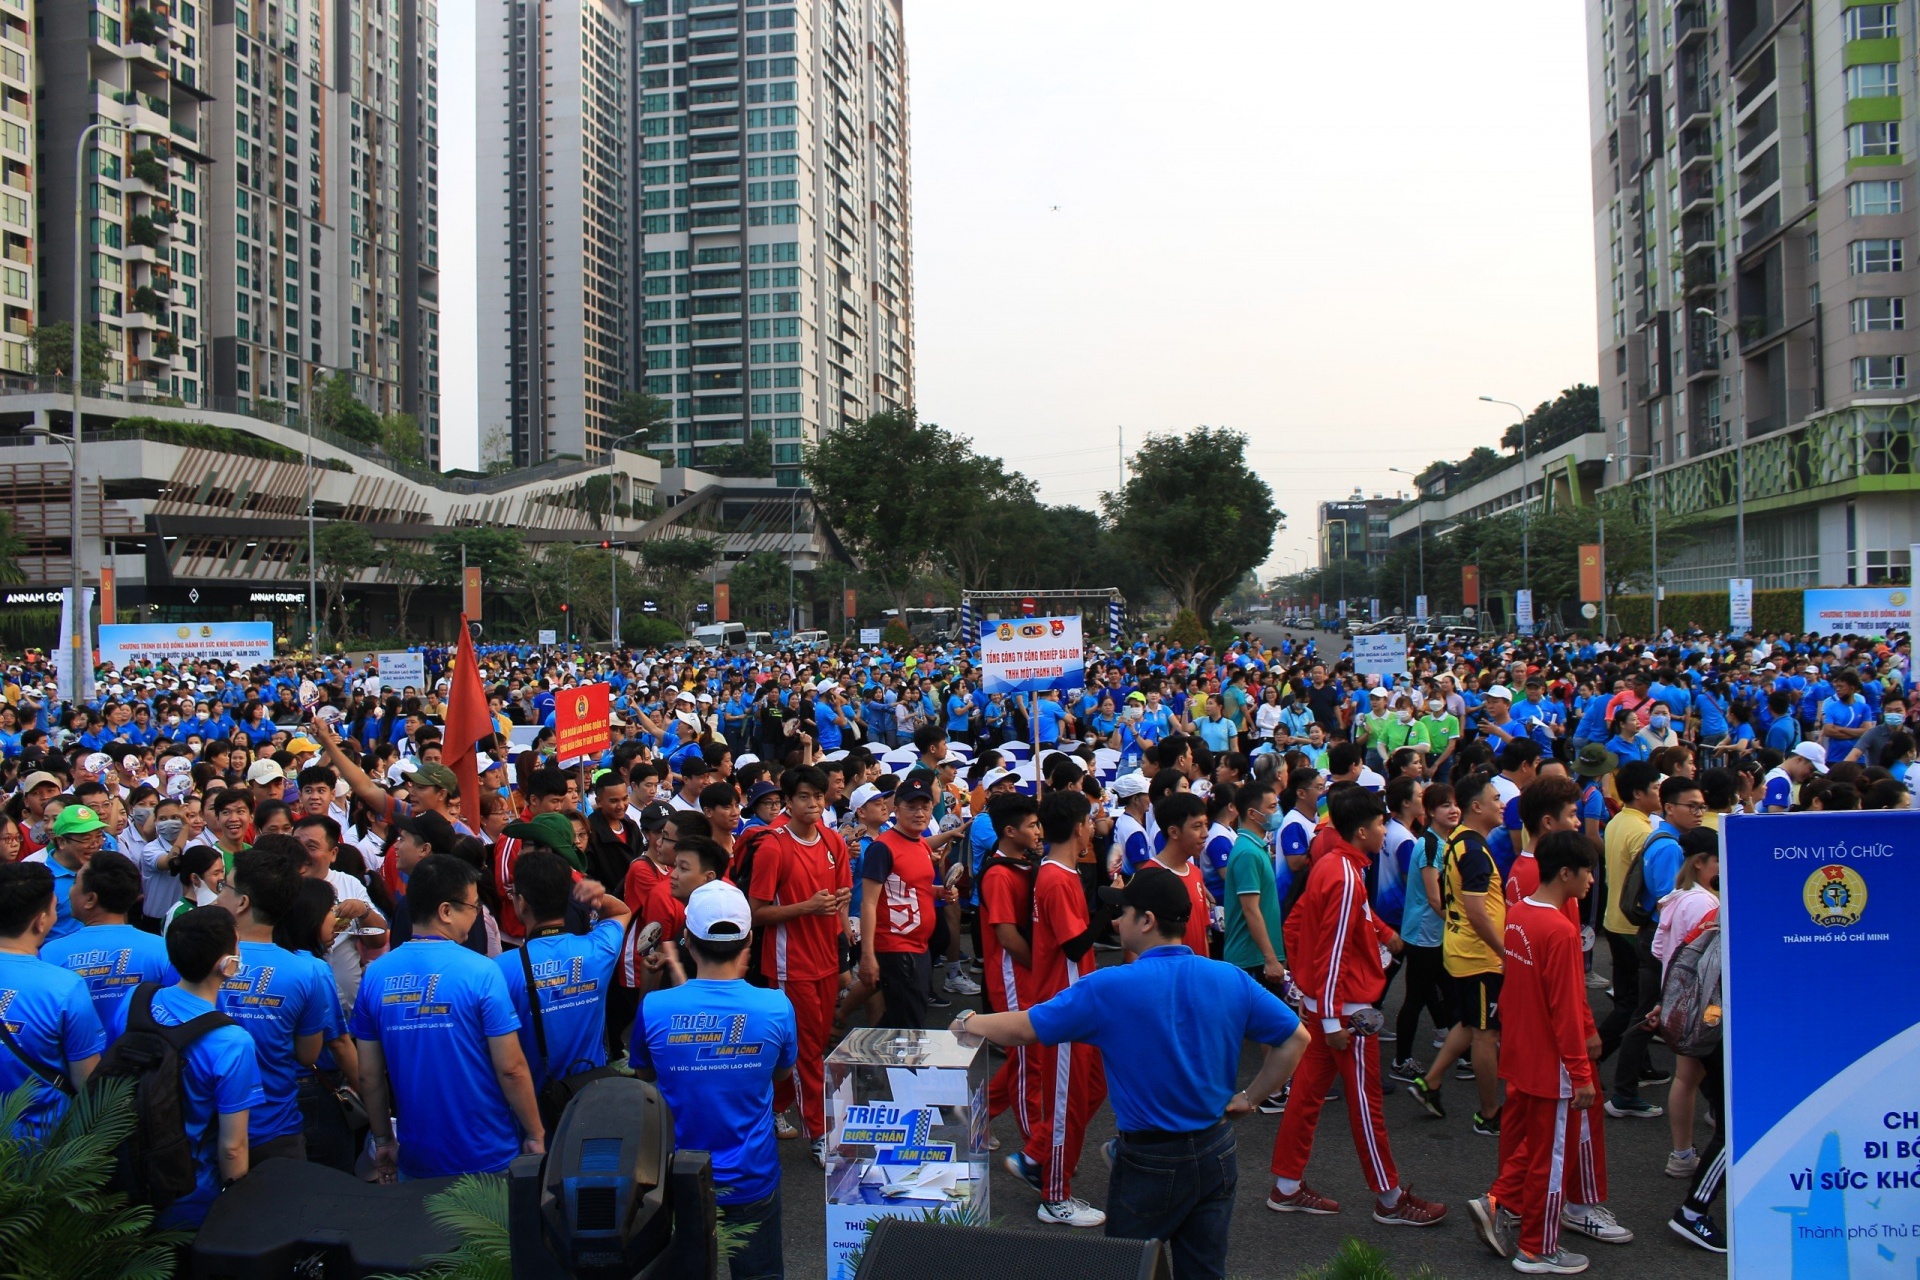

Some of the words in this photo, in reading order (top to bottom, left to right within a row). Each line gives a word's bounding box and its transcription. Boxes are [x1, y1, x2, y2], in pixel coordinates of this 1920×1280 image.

[6, 593, 44, 603] ANNAM
[250, 593, 274, 602] ANNAM
[275, 593, 305, 602] GOURMET
[1022, 626, 1043, 635] CNS
[986, 650, 999, 663] TỔNG
[1001, 651, 1016, 663] CÔNG
[1016, 652, 1022, 661] TY
[1024, 650, 1038, 661] CÔNG
[1040, 648, 1058, 662] NGHIỆP
[1059, 648, 1067, 659] SÀI
[1069, 647, 1079, 658] GÒN
[1005, 670, 1019, 679] TNHH
[1020, 666, 1032, 680] MỘT
[1033, 666, 1050, 677] THÀNH
[1051, 665, 1063, 677] VIÊN
[659, 806, 669, 816] LA
[1774, 846, 1808, 860] ĐƠN
[1811, 846, 1825, 860] VỊ
[1828, 840, 1847, 858] TỔ
[1851, 843, 1894, 858] CHỨC
[1783, 934, 1812, 943] THÀNH
[1814, 932, 1832, 942] PHỐ
[1834, 931, 1847, 942] HỒ
[1850, 933, 1865, 941] CHÍ
[1867, 933, 1889, 941] MINH
[68, 949, 108, 967] TRIỆU
[384, 972, 420, 992] TRIỆU
[1490, 1003, 1498, 1017] 7
[671, 1012, 718, 1032] TRIỆU
[669, 1034, 693, 1043] BƯỚC
[695, 1033, 722, 1042] CHÂN
[715, 1045, 734, 1055] TẤM
[735, 1046, 758, 1054] LÒNG
[847, 1105, 900, 1128] TRIỆU
[844, 1130, 873, 1141] BƯỚC
[875, 1131, 904, 1142] CHÂN
[897, 1147, 919, 1160] TẤM
[921, 1148, 946, 1160] LÒNG
[1864, 1141, 1888, 1159] ĐI
[1790, 1168, 1812, 1190] VÌ
[1820, 1167, 1868, 1190] SỨC
[845, 1220, 866, 1231] THÙ
[1798, 1226, 1844, 1238] Thành
[1848, 1223, 1878, 1240] phố
[1882, 1223, 1907, 1237] Thủ
[840, 1251, 848, 1259] VÌ
